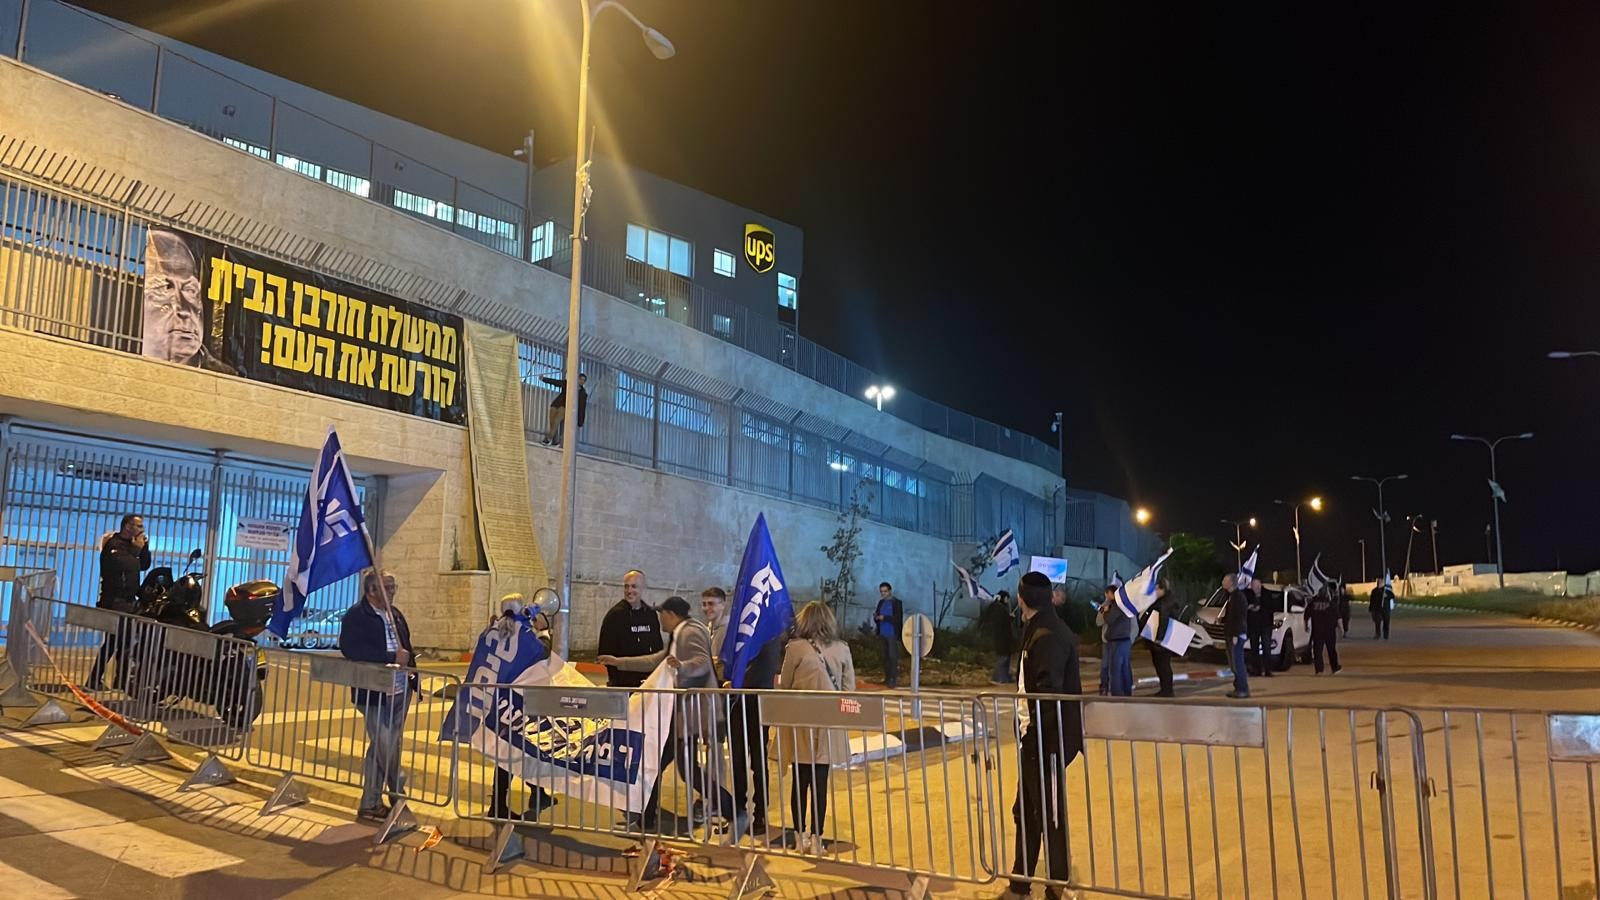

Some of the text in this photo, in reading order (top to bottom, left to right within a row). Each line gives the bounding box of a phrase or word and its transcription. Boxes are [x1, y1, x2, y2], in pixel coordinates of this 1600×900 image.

[747, 236, 773, 266] ups
[208, 256, 457, 365] ממשלת חורבן הבית
[260, 322, 456, 409] קורעת את העם!
